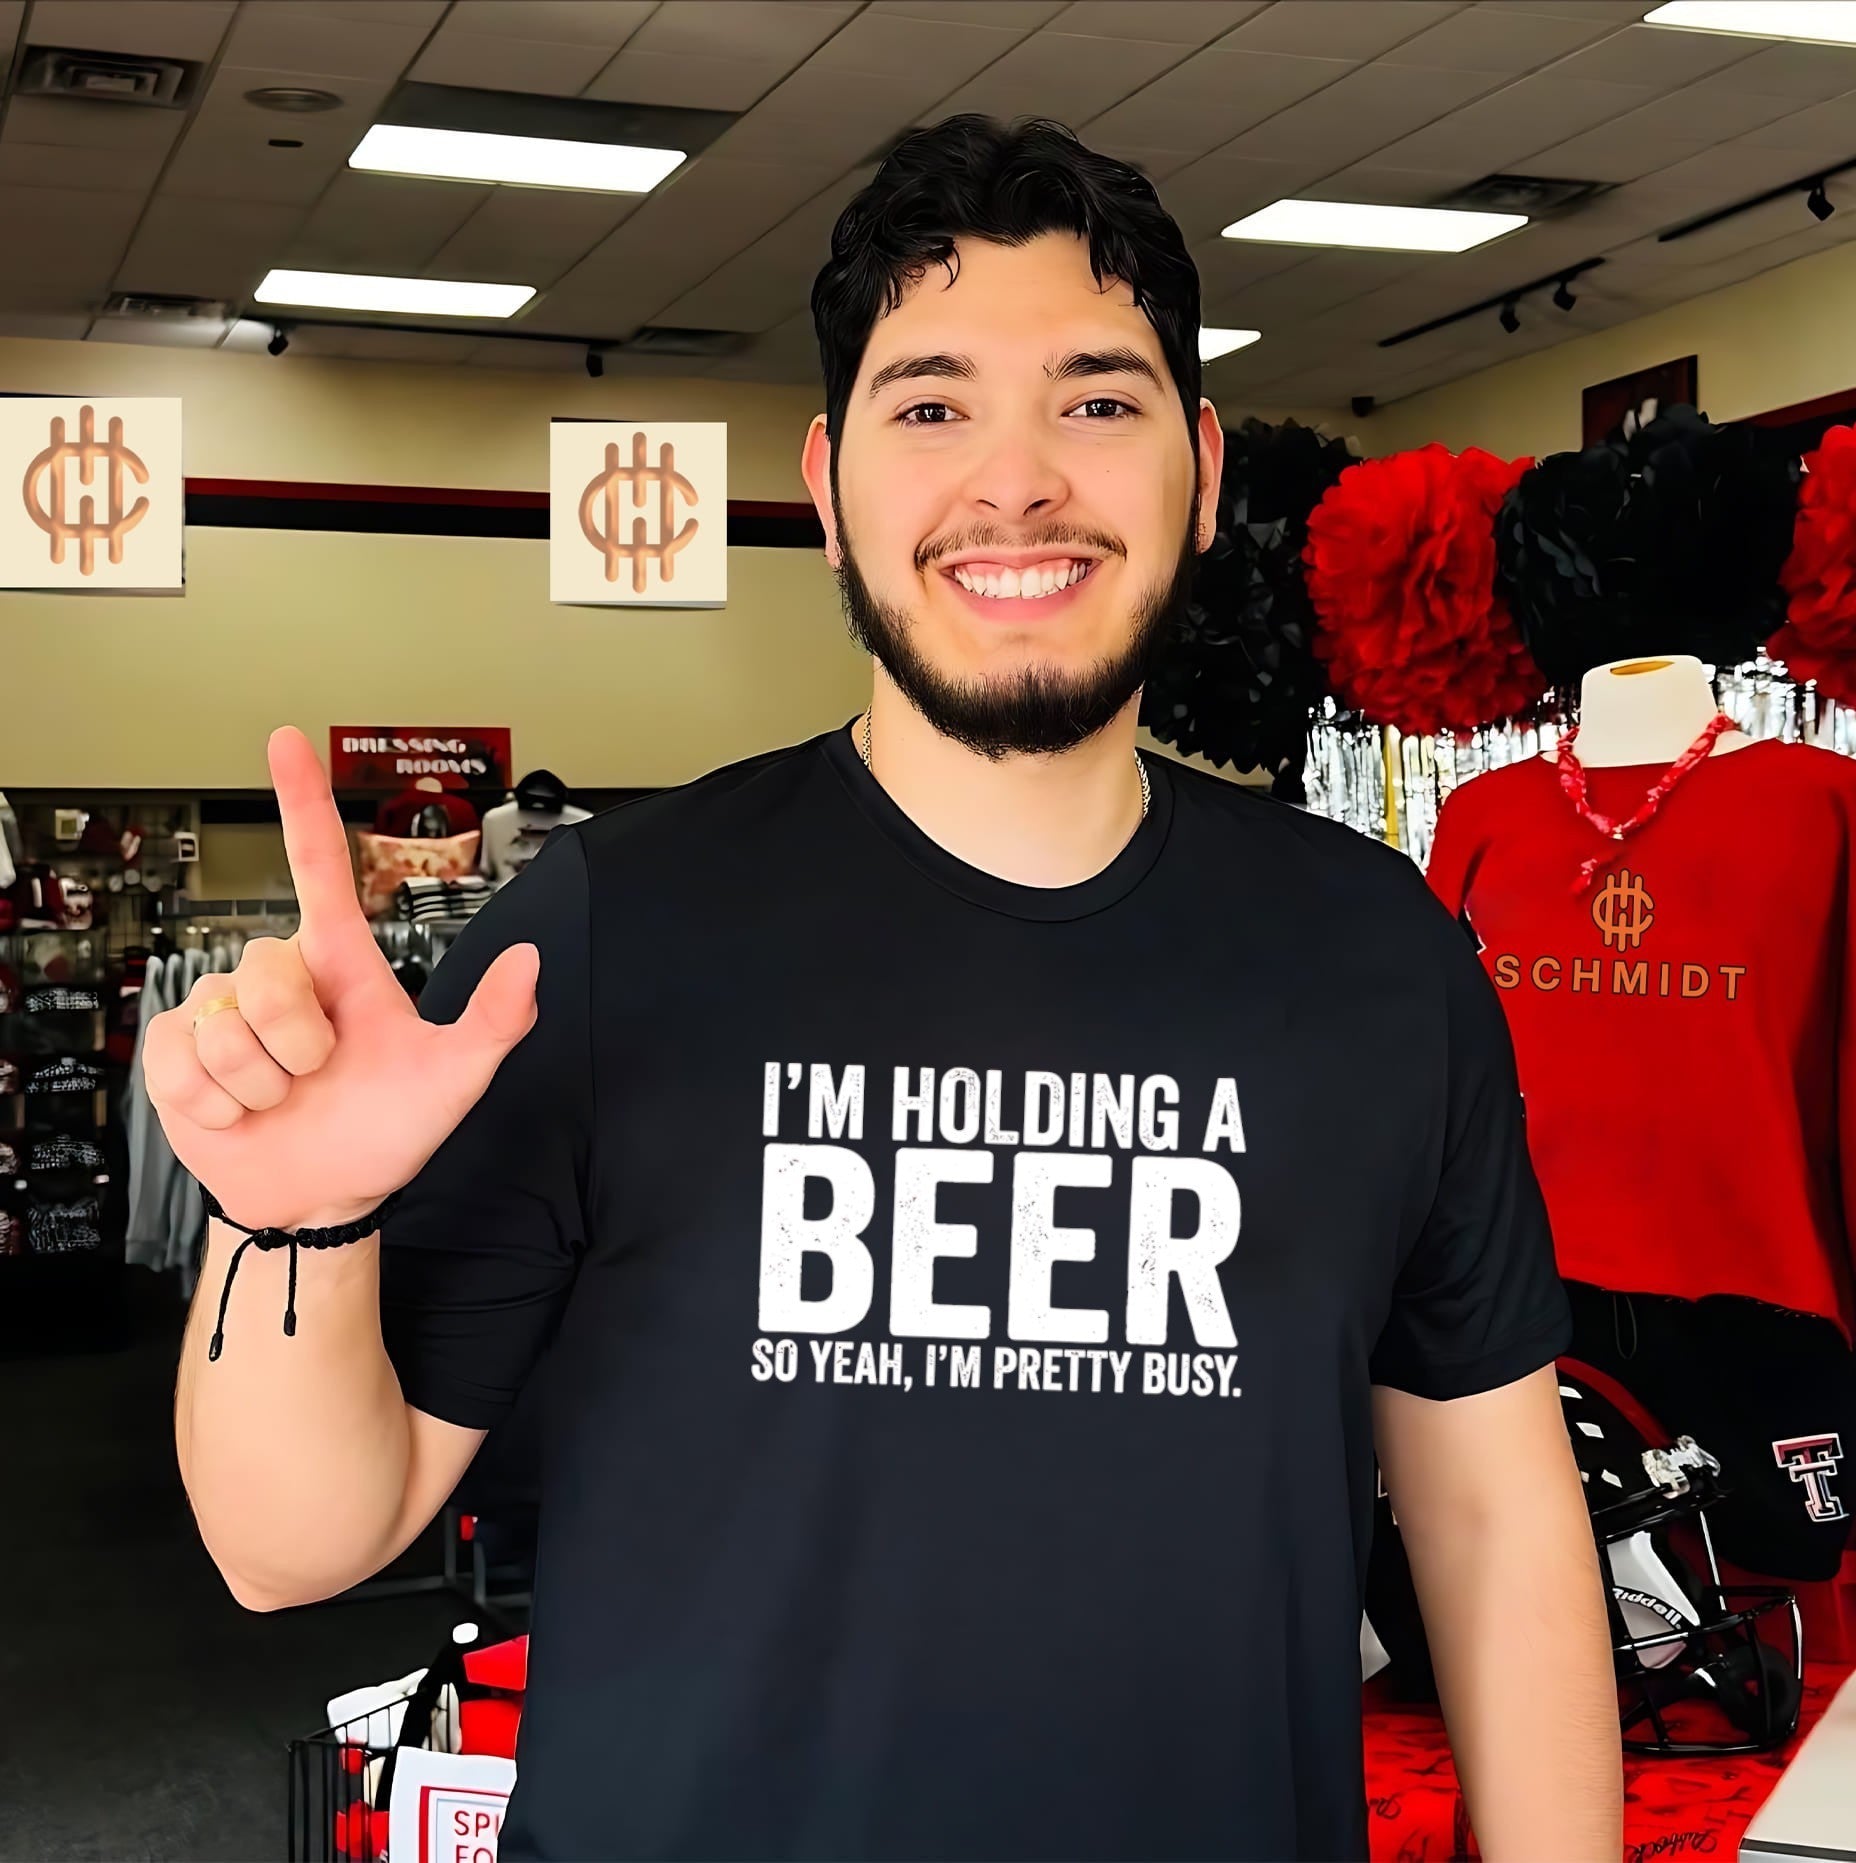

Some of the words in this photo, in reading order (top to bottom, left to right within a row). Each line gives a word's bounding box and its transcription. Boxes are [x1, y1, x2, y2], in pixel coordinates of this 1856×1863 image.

[395, 758, 488, 775] ROOMS
[1494, 953, 1747, 1000] SCHMIDT
[763, 1062, 865, 1139] I'M
[892, 1067, 1179, 1150] HOLDING
[1203, 1078, 1246, 1152] A
[759, 1143, 1240, 1347] BEER
[752, 1339, 797, 1381] SO
[810, 1341, 912, 1391] YEAH,
[926, 1345, 981, 1387] I'M
[994, 1347, 1132, 1392] PRETTY
[1143, 1353, 1241, 1397] BUSY.
